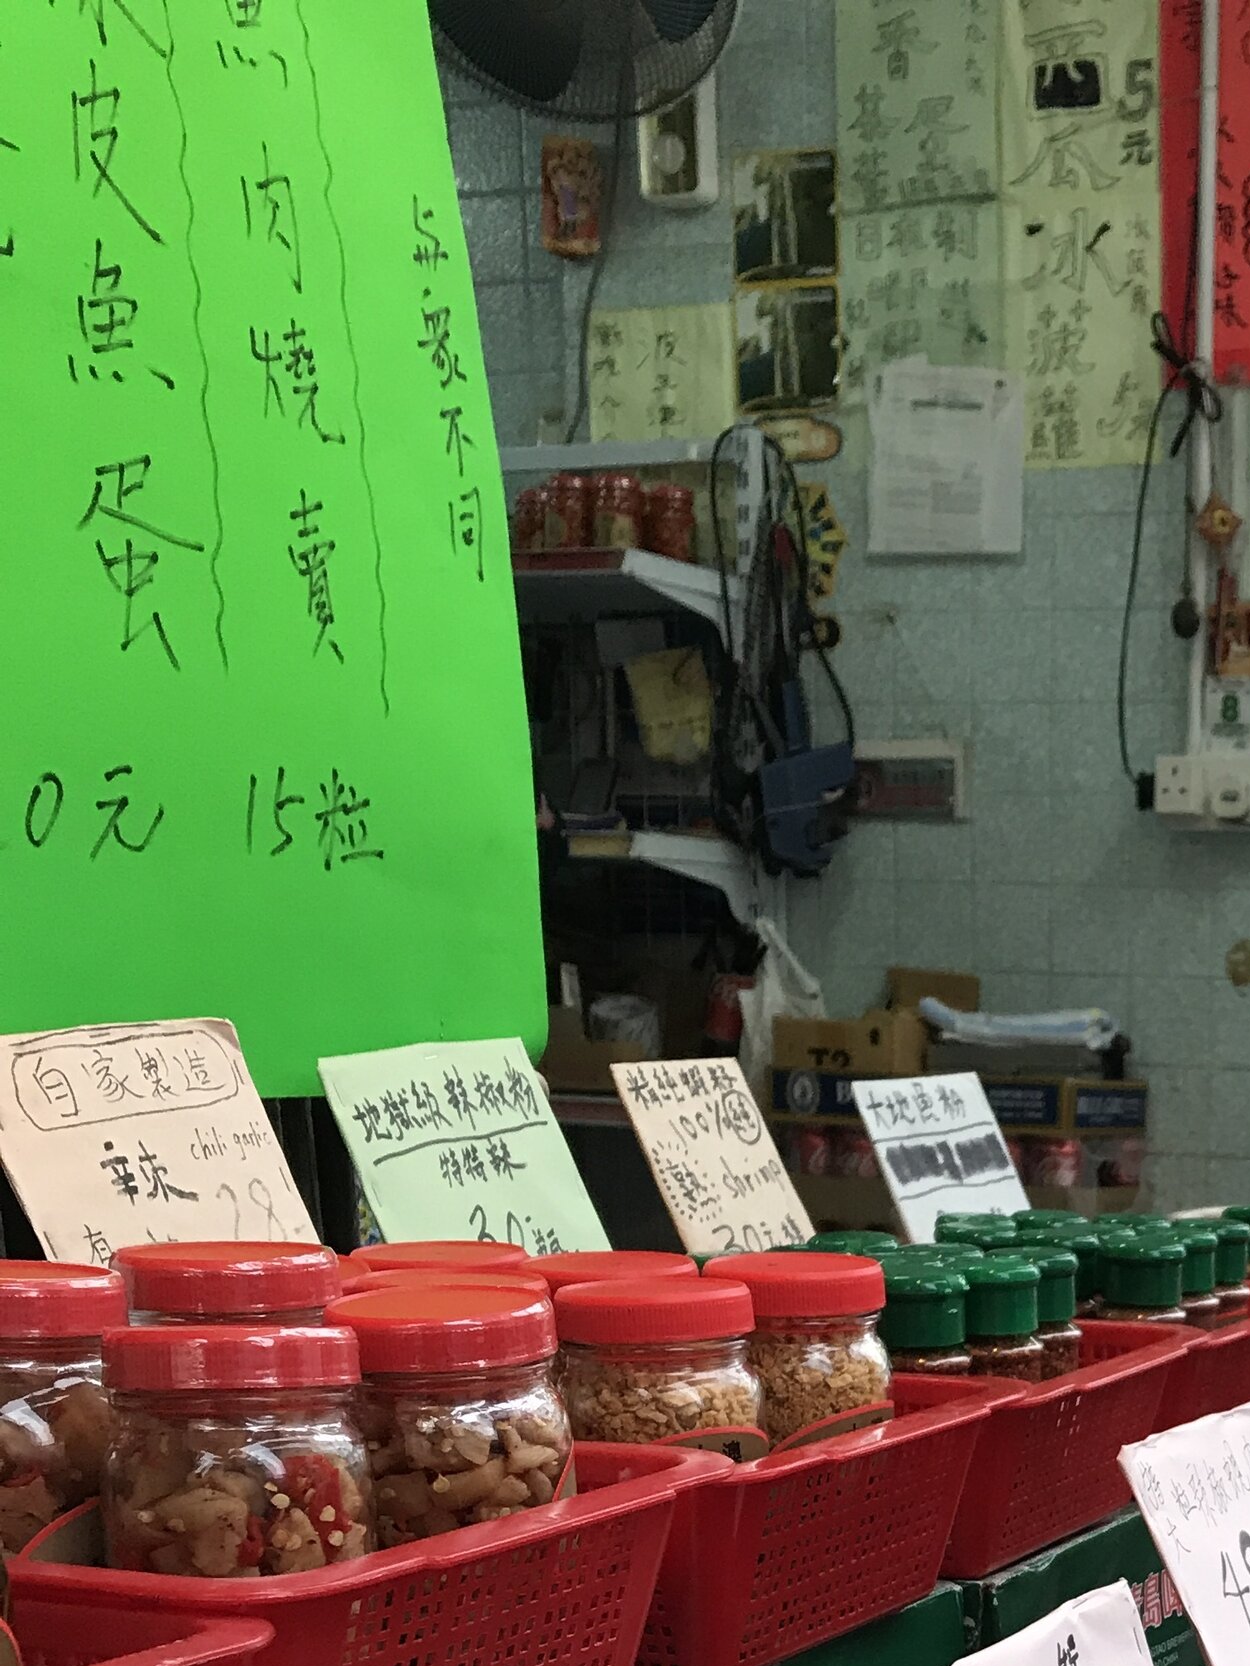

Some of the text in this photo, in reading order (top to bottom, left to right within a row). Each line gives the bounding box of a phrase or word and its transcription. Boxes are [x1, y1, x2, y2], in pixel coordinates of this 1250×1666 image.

[32, 1048, 225, 1119] 自家製造
[352, 1056, 540, 1144] 地獄級辣椒粉
[190, 1120, 272, 1161] chili garlic
[438, 1137, 527, 1188] 特特辣
[100, 1141, 200, 1206] 辣
[719, 1155, 786, 1199] shrimp
